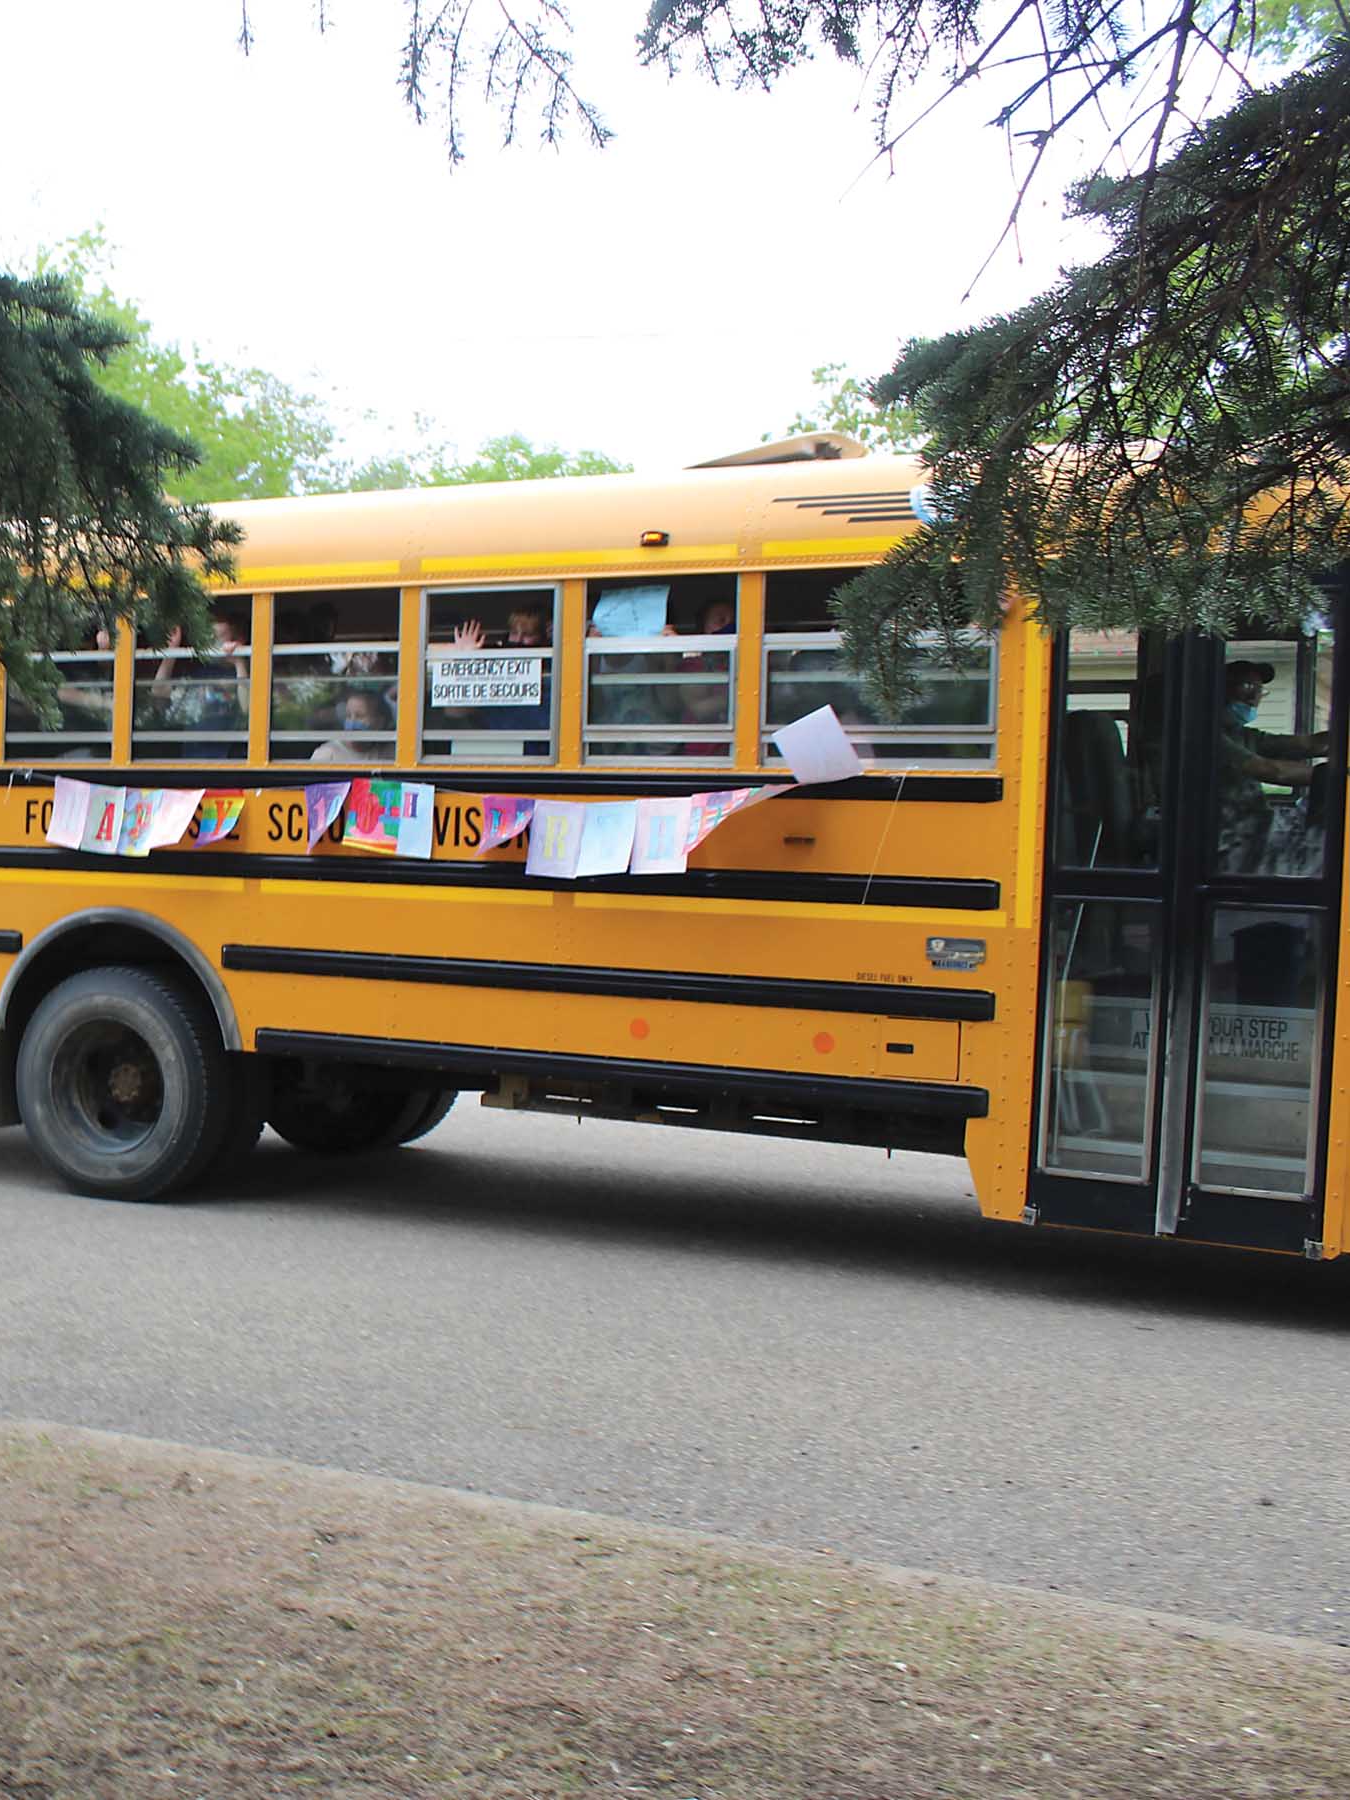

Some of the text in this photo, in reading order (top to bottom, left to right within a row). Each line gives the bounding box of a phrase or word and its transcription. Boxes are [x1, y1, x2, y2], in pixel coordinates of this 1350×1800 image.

[441, 660, 532, 676] EMERGENCY EXIT
[433, 682, 539, 699] SORTIE DE SECOURS
[1249, 1018, 1288, 1040] STEP
[1241, 1038, 1299, 1062] MARCHE
